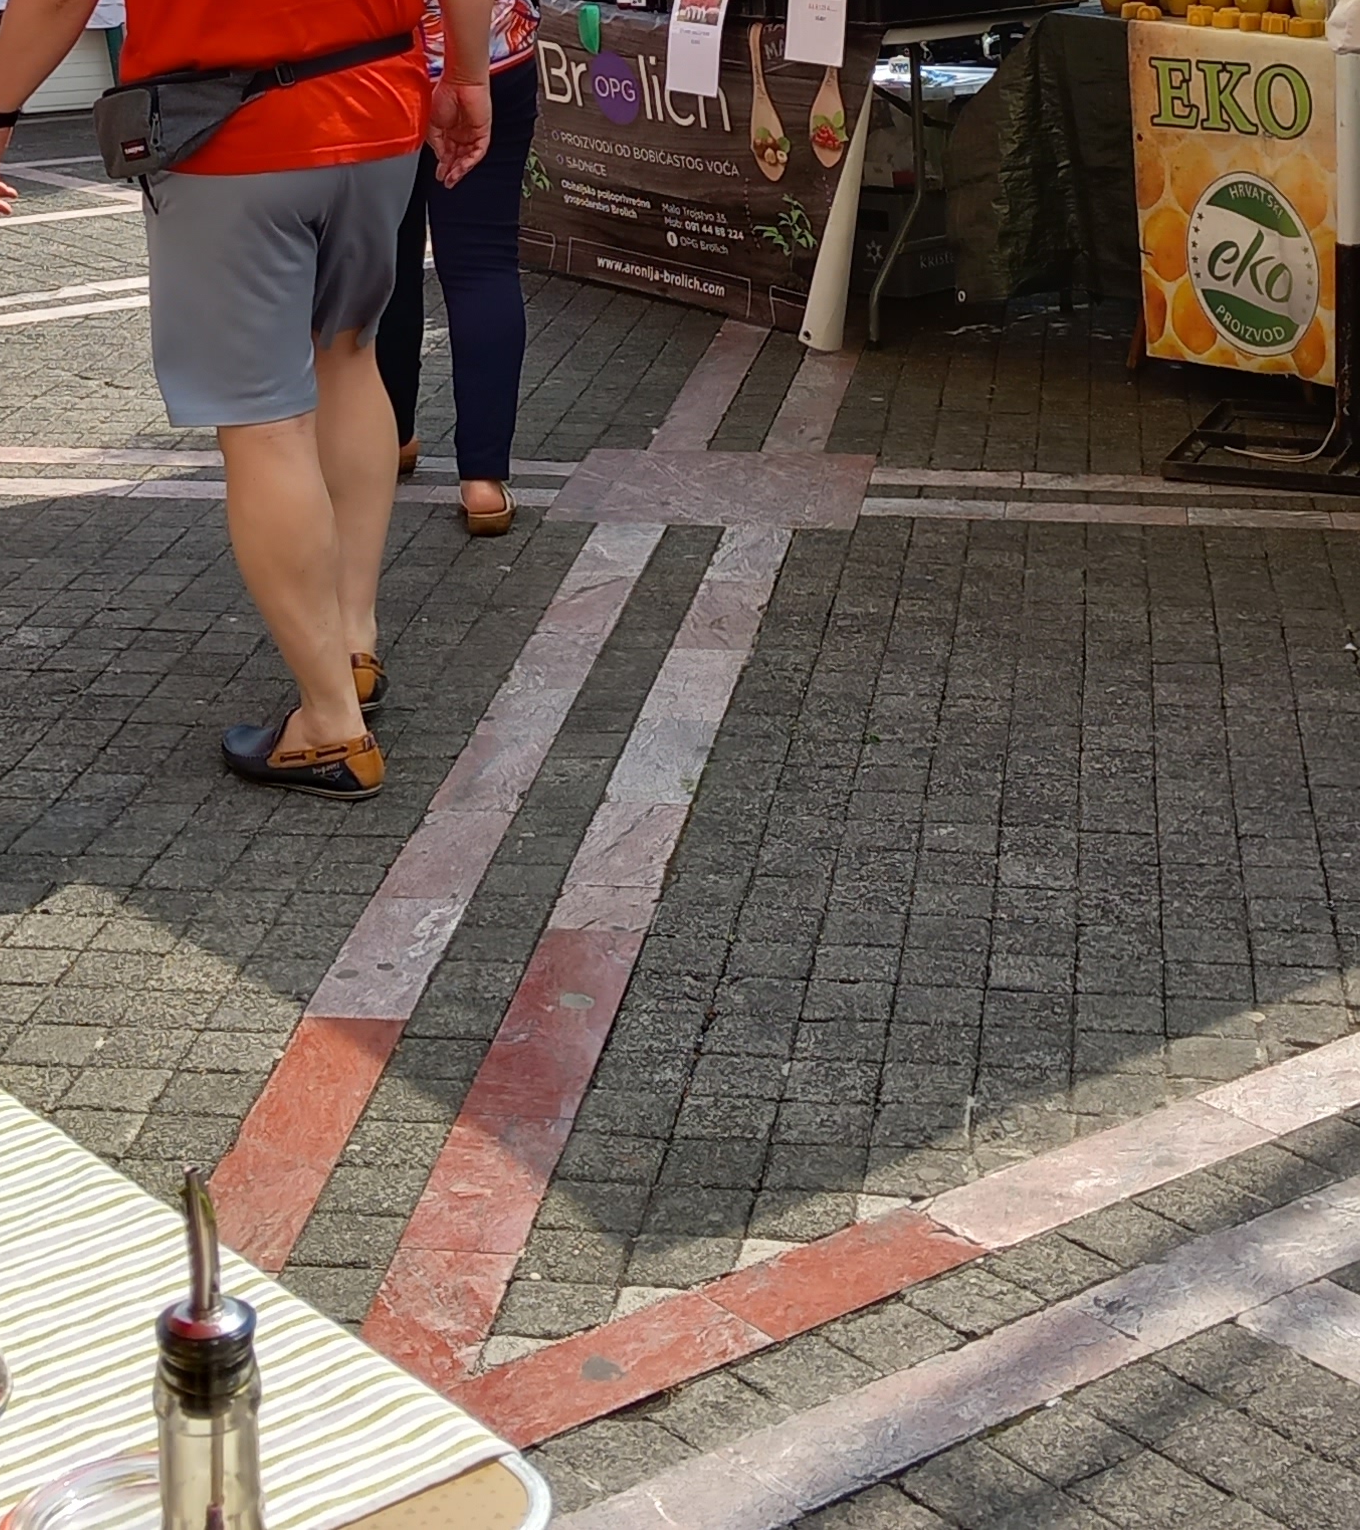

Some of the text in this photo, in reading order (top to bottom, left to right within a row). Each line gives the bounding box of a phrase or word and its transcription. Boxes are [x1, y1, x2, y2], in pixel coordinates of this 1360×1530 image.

[594, 75, 637, 102] OPG
[1149, 56, 1313, 140] EKO
[614, 143, 631, 159] OD
[706, 158, 740, 177] VOĆA
[1228, 184, 1284, 219] HRVATSKI
[701, 223, 714, 236] 44
[596, 256, 726, 298] www.aronija-brolich.com
[1207, 227, 1294, 304] eko
[1215, 304, 1286, 343] PROIZVOD
